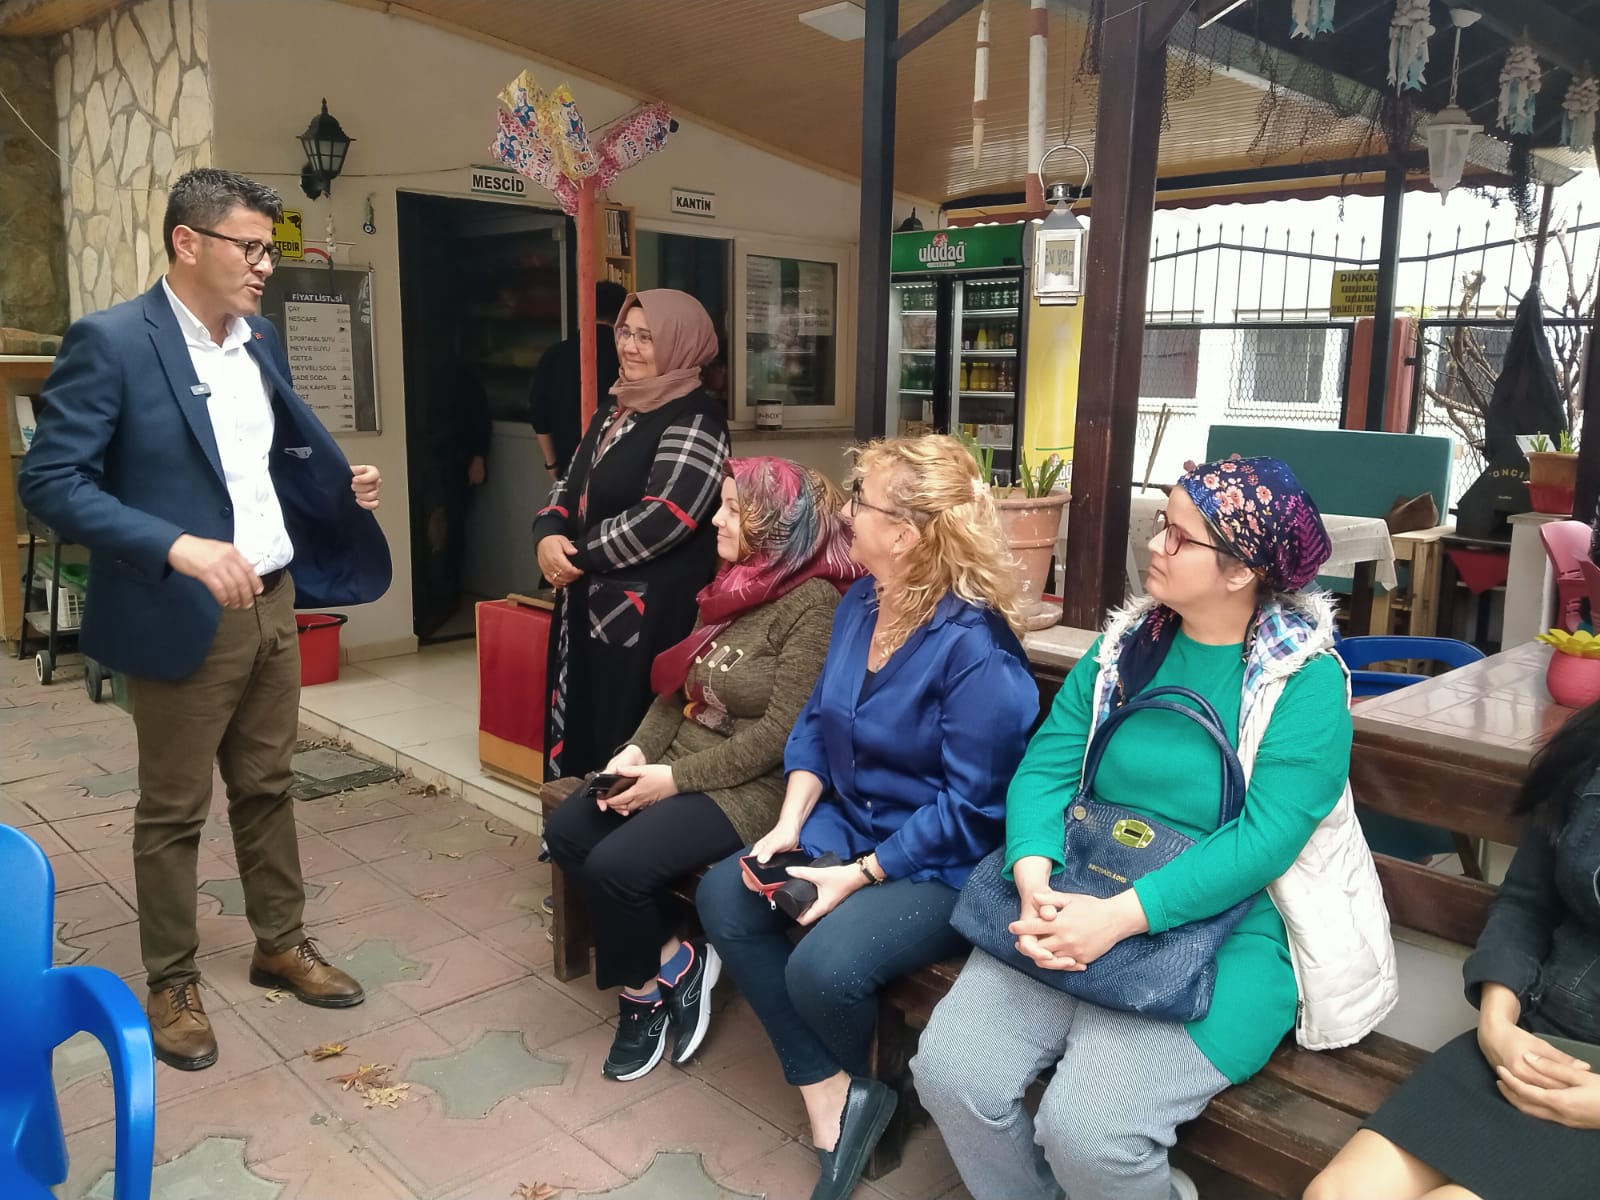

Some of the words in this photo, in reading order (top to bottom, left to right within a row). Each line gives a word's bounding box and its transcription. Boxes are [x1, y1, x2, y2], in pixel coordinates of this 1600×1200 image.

[472, 174, 525, 192] MESCİD
[676, 196, 711, 211] KANTİN
[919, 241, 966, 263] uludağ
